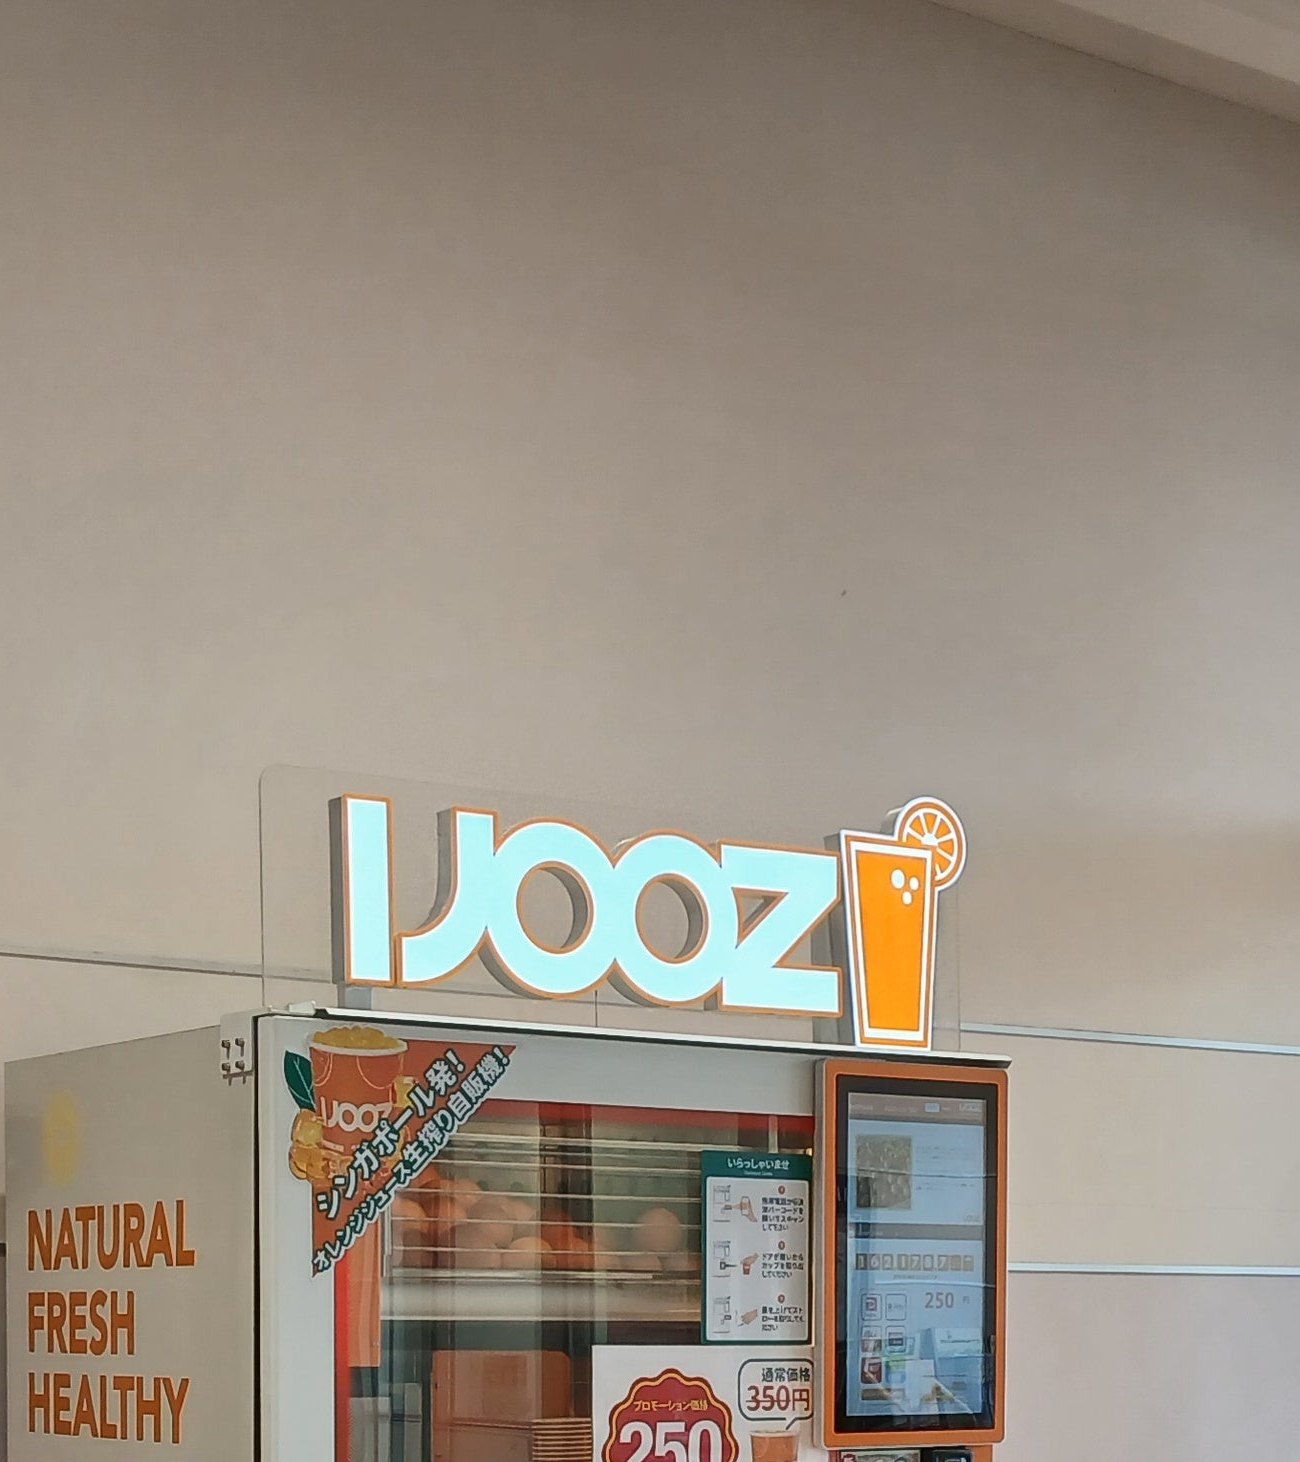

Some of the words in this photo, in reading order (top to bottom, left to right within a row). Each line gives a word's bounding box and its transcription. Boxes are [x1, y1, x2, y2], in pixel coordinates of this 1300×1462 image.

[334, 794, 842, 1017] IJOOZ
[28, 1200, 196, 1271] NATURAL
[28, 1290, 135, 1355] FRESH
[925, 1292, 954, 1309] 250
[745, 1385, 810, 1412] 350円
[761, 1367, 811, 1383] 通常価格
[29, 1372, 190, 1444] HEALTHY
